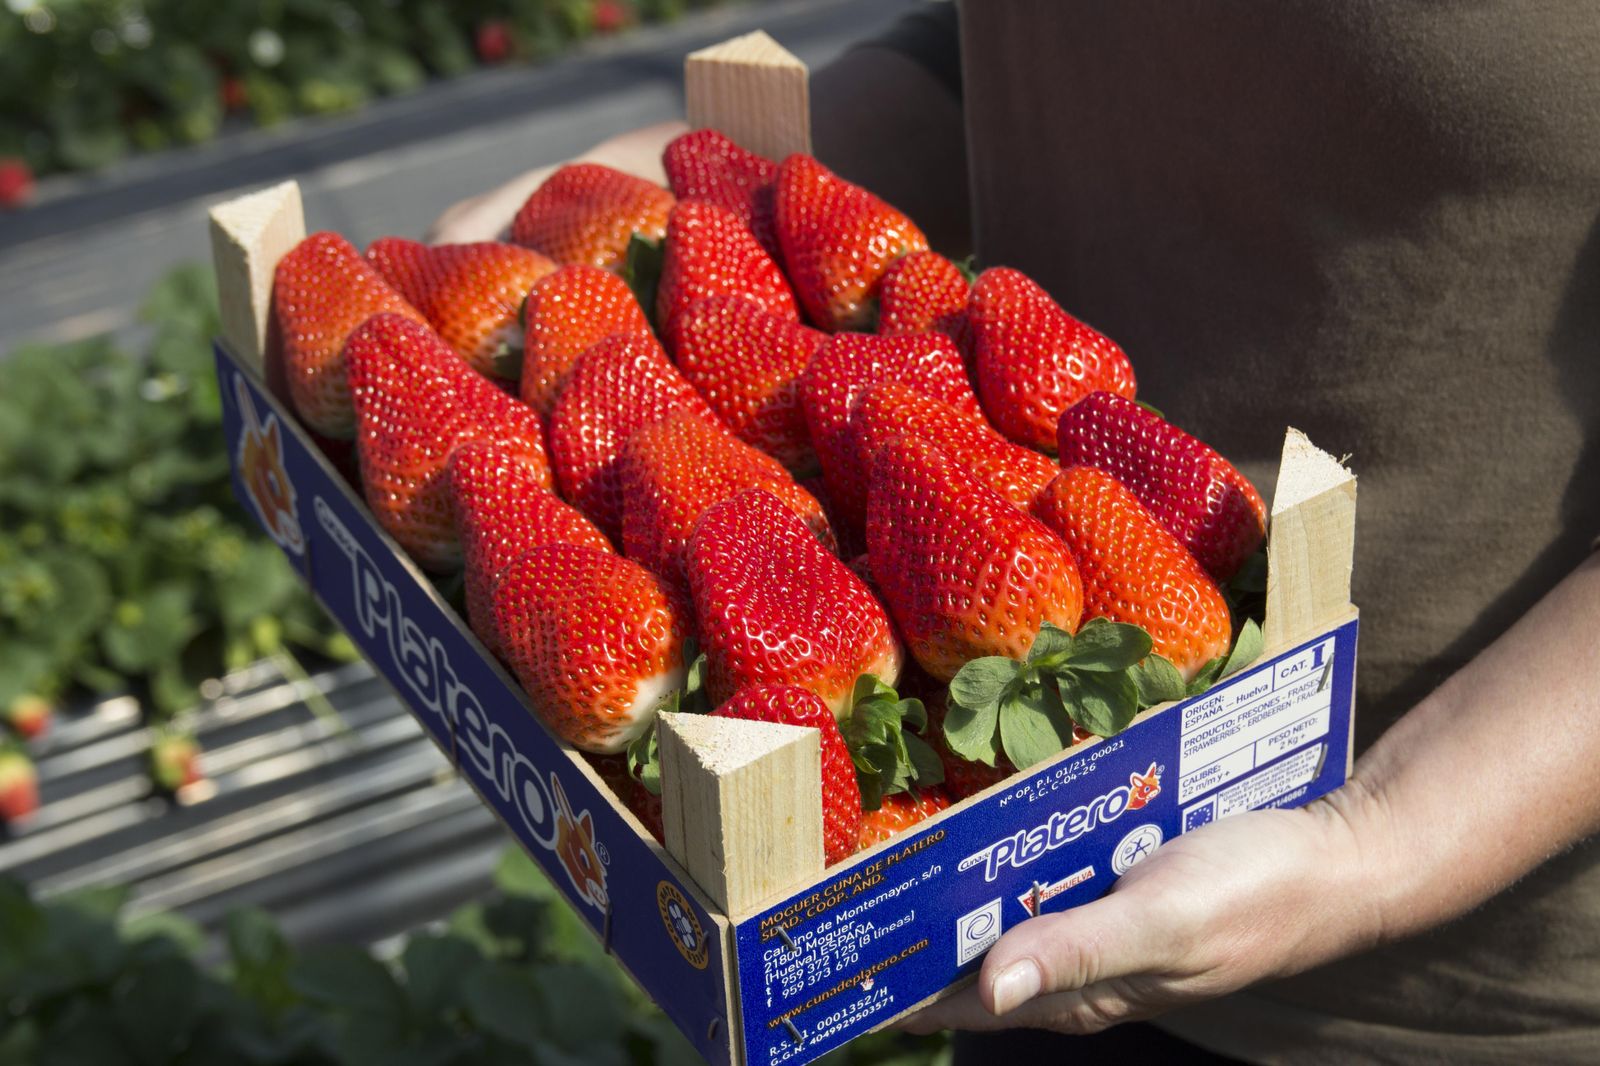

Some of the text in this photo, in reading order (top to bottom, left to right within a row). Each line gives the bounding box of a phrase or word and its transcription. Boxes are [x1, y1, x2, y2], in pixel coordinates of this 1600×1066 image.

[1280, 643, 1325, 678] CAT. I
[352, 546, 559, 850] Platero
[1184, 718, 1235, 748] PRODUCTO:
[1237, 697, 1279, 722] FRESONES
[1185, 703, 1222, 728] ESPAÑA
[1236, 682, 1268, 703] Huelva
[1185, 694, 1224, 718] ORIGEN:
[1184, 725, 1240, 757] STRAWBERRIES
[1247, 700, 1291, 726] ERDBEEREN
[1268, 716, 1317, 745] PESO NETO:
[1280, 741, 1285, 750] 2
[1016, 786, 1033, 800] OP.
[1037, 777, 1052, 789] P.I.
[1056, 740, 1124, 777] 01/21-00021
[1029, 765, 1096, 802] E.C. C-04-26
[1182, 786, 1193, 798] 22
[1196, 776, 1215, 791] m/m
[1217, 773, 1221, 782] y
[1183, 764, 1220, 787] CALIBRE:
[985, 786, 1131, 882] Platero
[761, 828, 944, 929] MOGUER CUNA DE PLATERO
[761, 871, 884, 941] SDAD. COOP. AND.
[816, 918, 832, 934] de
[836, 874, 918, 926] Montemayor,
[922, 861, 941, 880] s/n
[1039, 871, 1092, 899] RESHUELVA
[764, 919, 855, 973] 21800 Moguer
[765, 918, 874, 984] (Huelva) ESPAÑA
[766, 910, 914, 996] t 959 372 125 (8 líneas)
[766, 952, 858, 1008] f 959 373 670
[769, 937, 928, 1029] www.cunadeplatero.com
[770, 995, 893, 1065] G.G.N. 4049929503571
